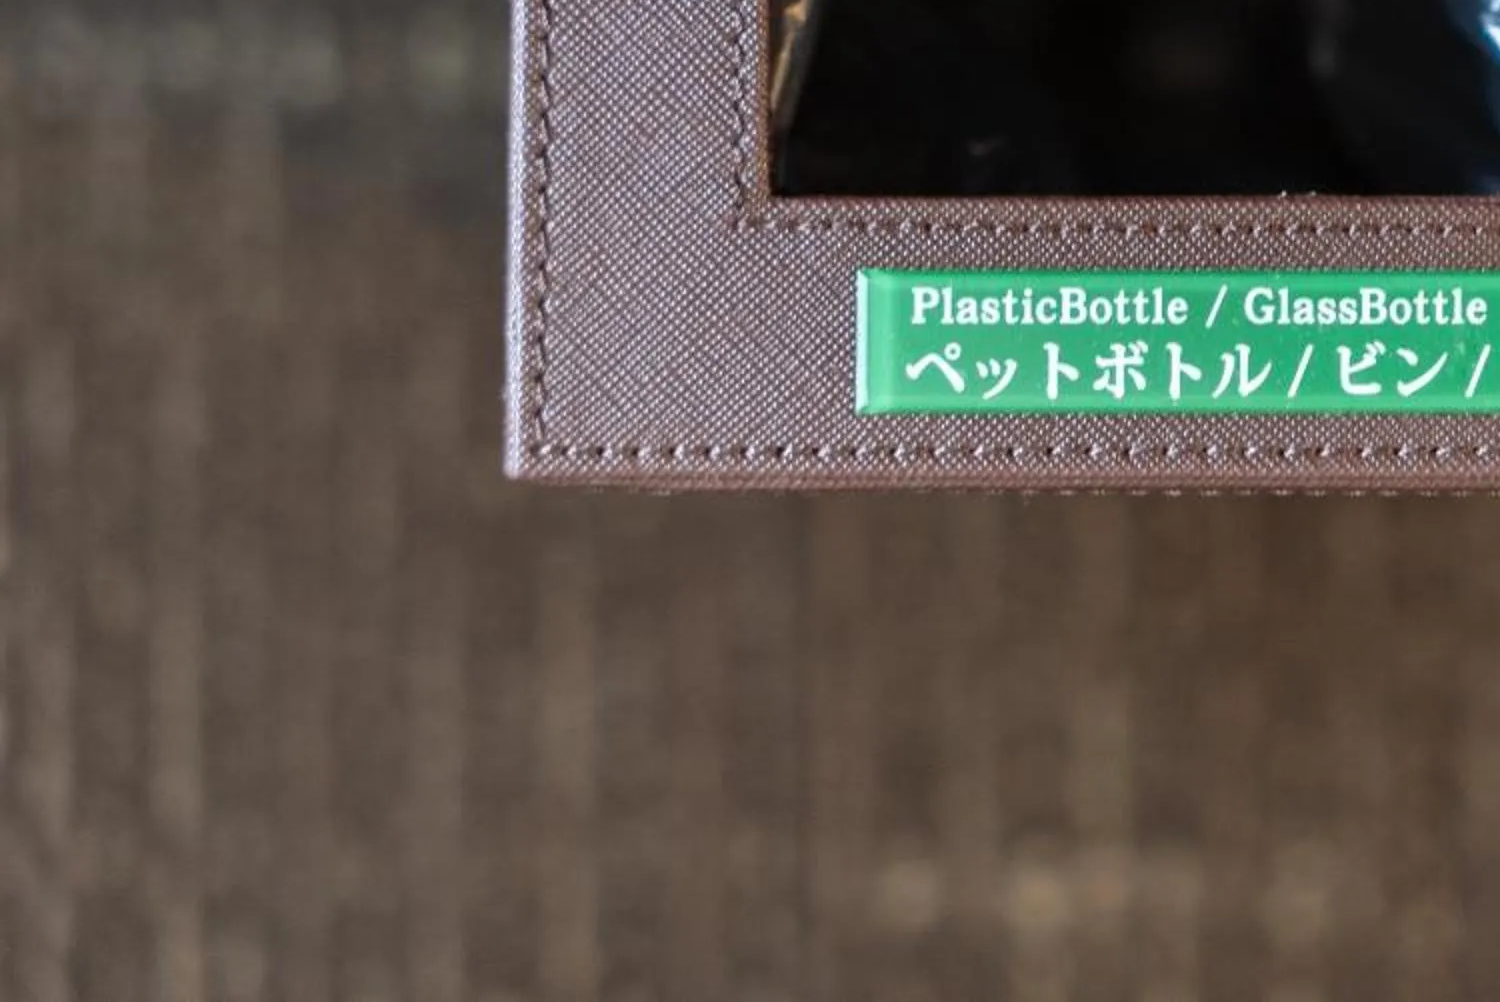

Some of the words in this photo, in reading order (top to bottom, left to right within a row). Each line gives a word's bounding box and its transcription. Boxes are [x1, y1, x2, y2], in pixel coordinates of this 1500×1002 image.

[910, 285, 1188, 326] PlasticBottle
[1204, 285, 1228, 328] /
[1243, 285, 1487, 326] GlassBottle
